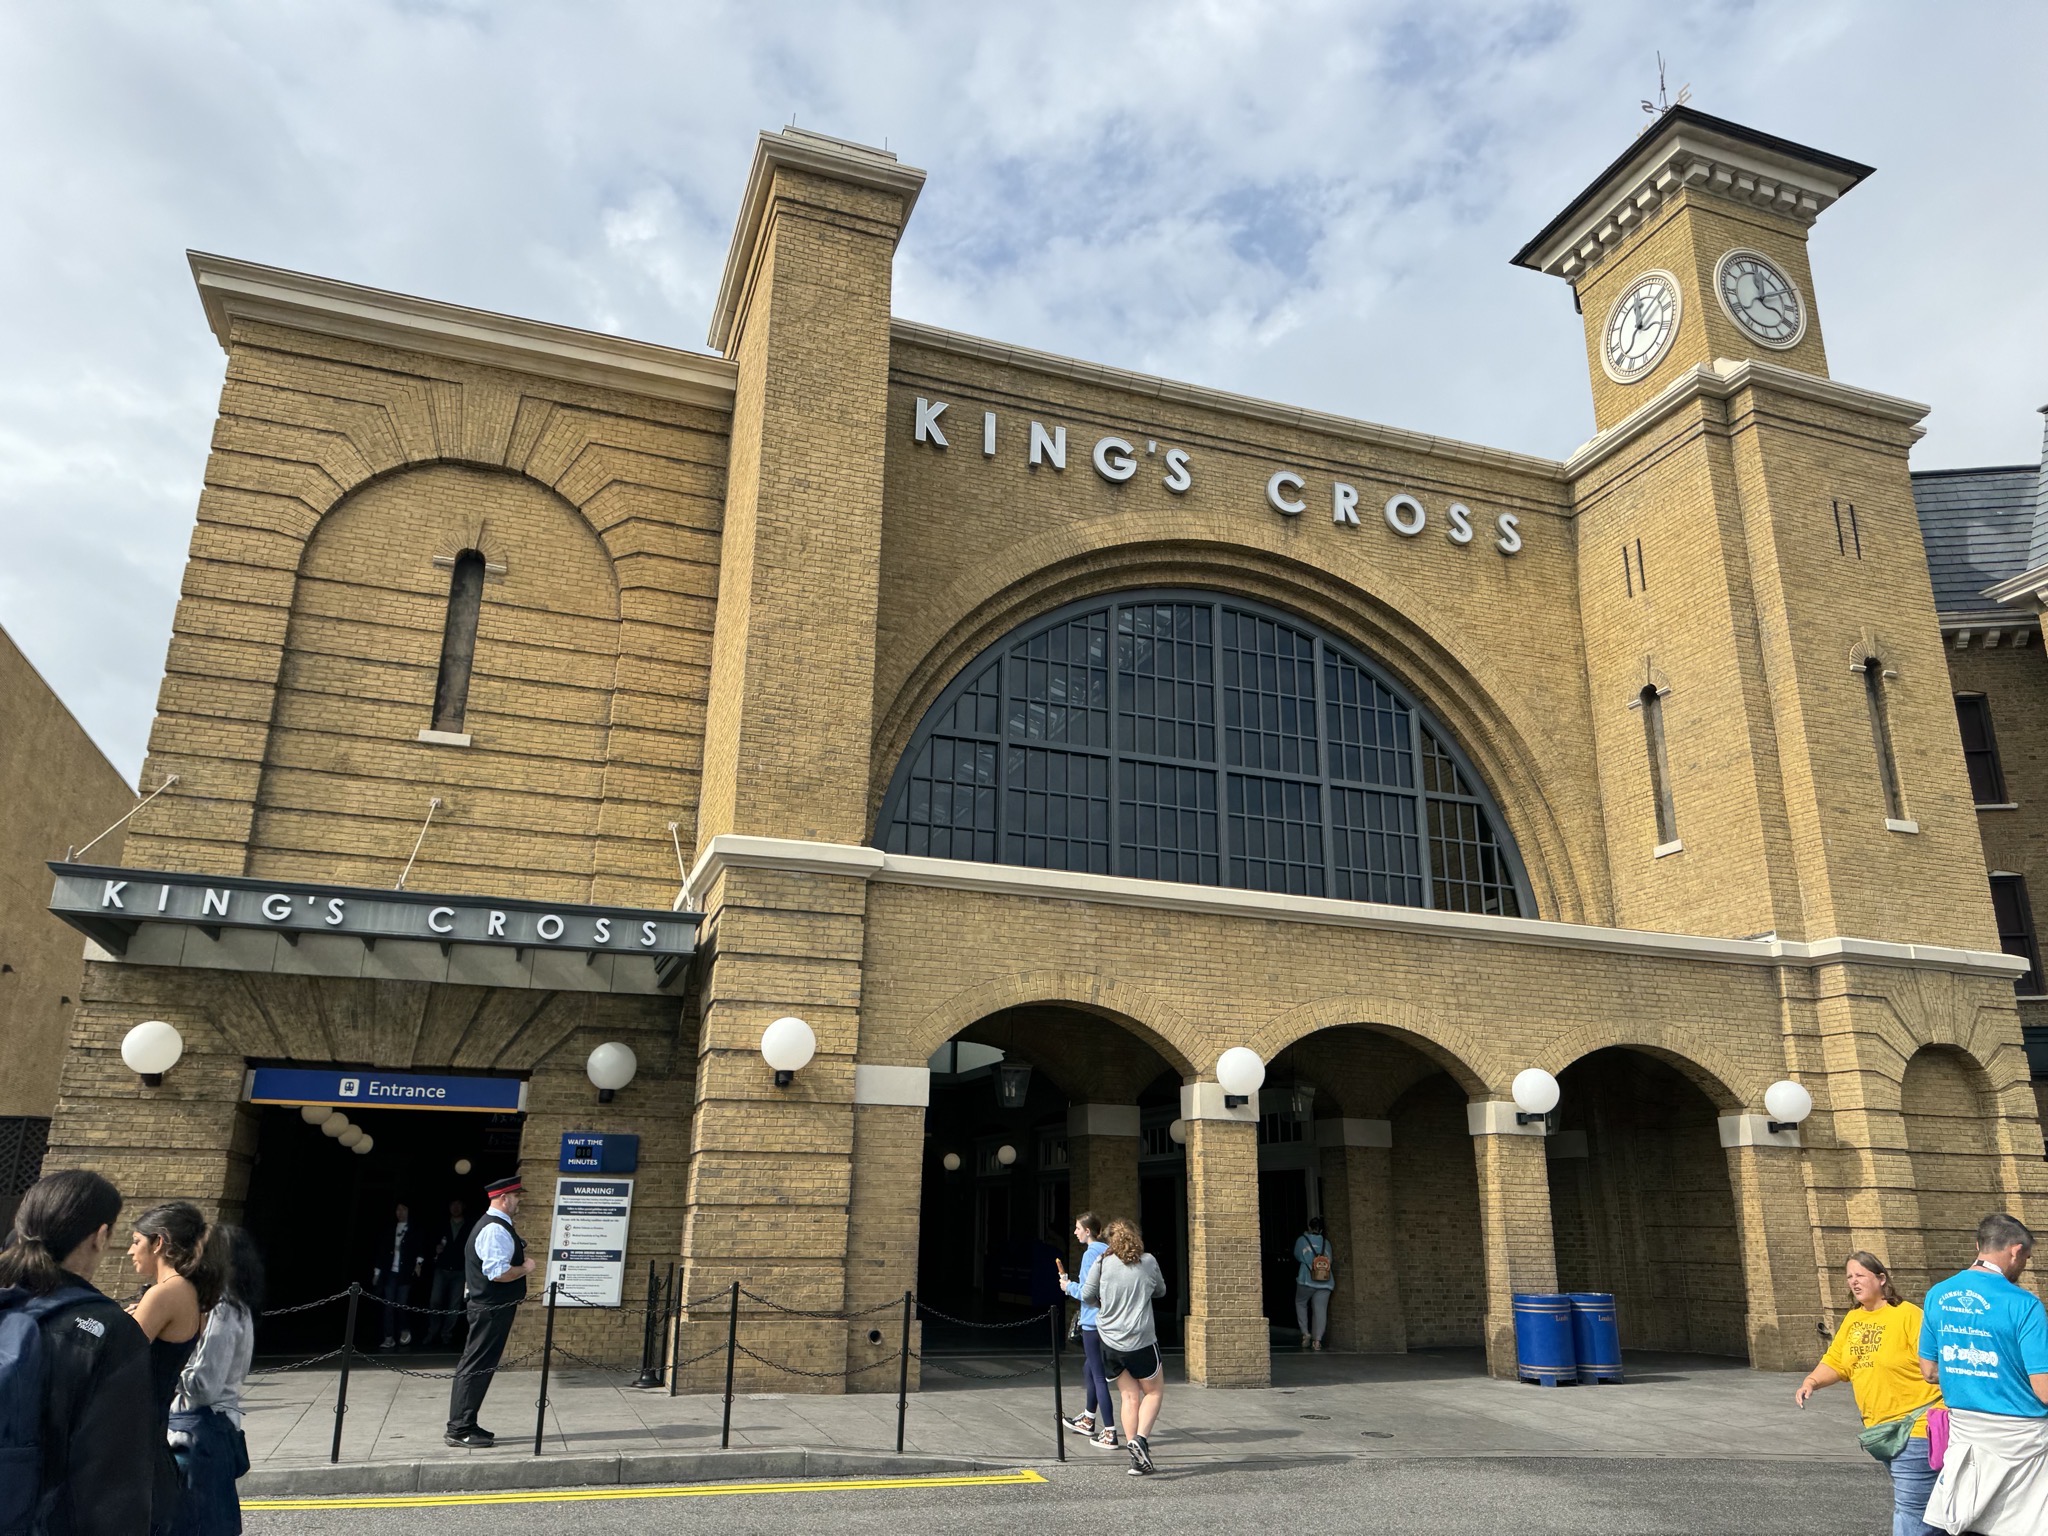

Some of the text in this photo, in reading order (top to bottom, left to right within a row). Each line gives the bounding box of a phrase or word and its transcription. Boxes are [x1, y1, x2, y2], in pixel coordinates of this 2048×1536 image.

[914, 396, 1523, 555] KING'S CROSS
[101, 880, 657, 946] KING'S CROSS
[368, 1081, 447, 1099] Entrance
[567, 1138, 585, 1146] WAIT
[567, 1158, 598, 1166] MINUTES
[573, 1186, 615, 1196] WARNING!
[1861, 1329, 1883, 1345] BIG
